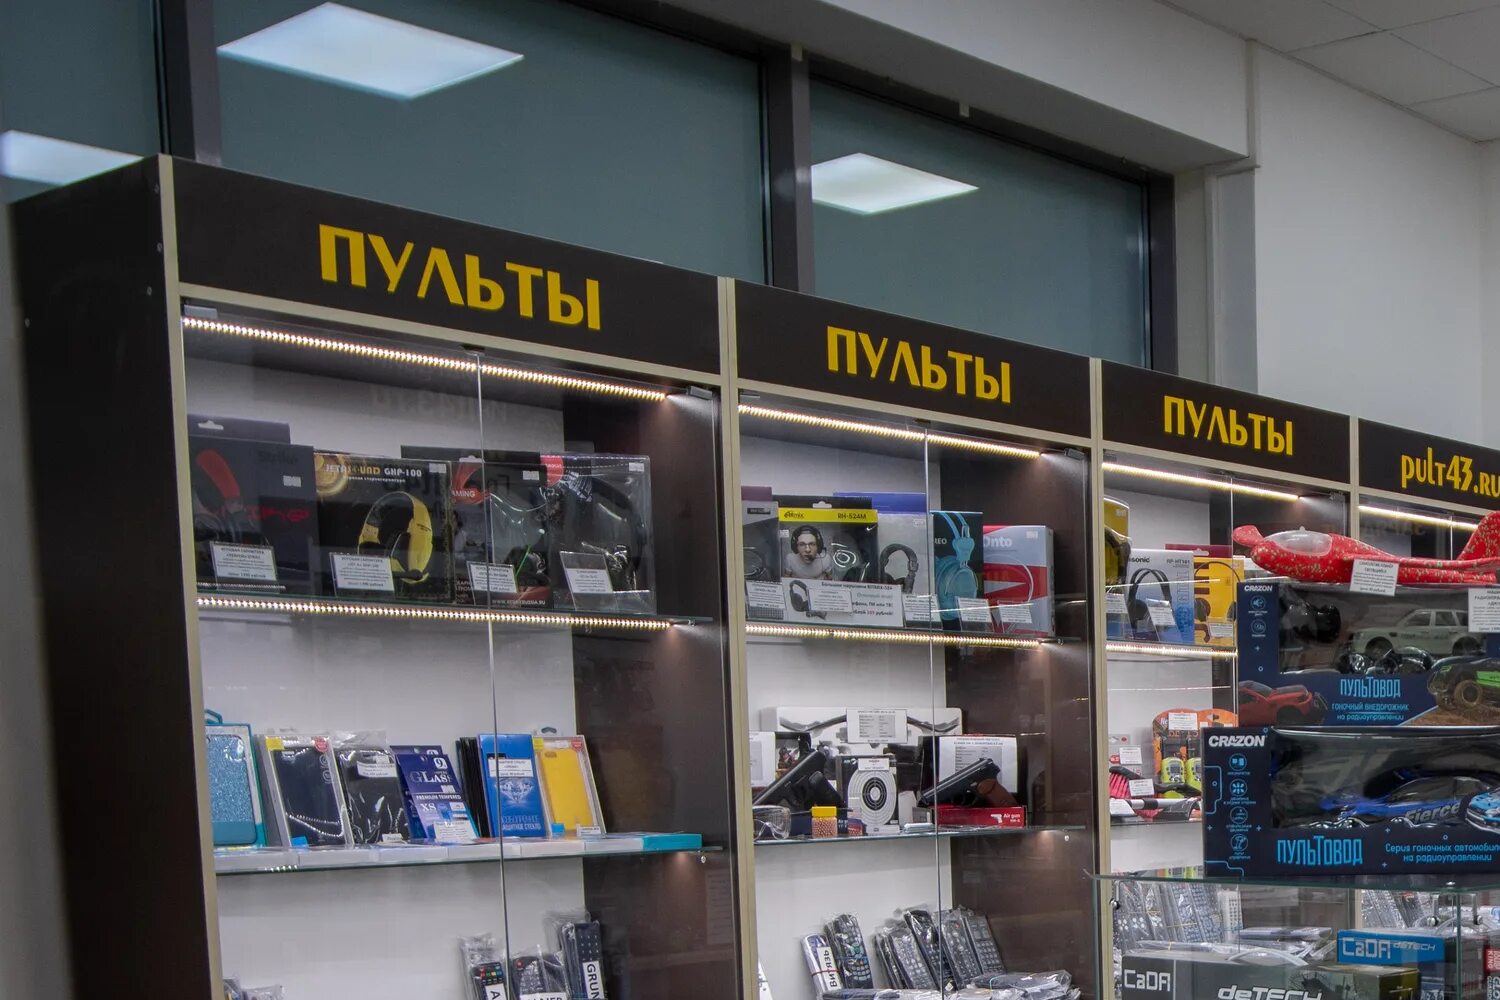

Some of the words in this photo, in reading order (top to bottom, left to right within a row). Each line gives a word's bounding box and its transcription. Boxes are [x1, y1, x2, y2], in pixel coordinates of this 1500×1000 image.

[318, 223, 601, 331] ПУЛЬТЫ
[826, 325, 1011, 404] ПУЛЬТЫ
[1163, 395, 1293, 456] ПУЛЬТЫ
[452, 490, 475, 498] AMING
[1208, 735, 1266, 747] CRAZON
[1385, 842, 1411, 853] Серия
[1412, 844, 1452, 852] гоночных
[1403, 854, 1415, 862] на
[1416, 853, 1493, 864] радиоуправлении
[1124, 969, 1171, 992] CaDA
